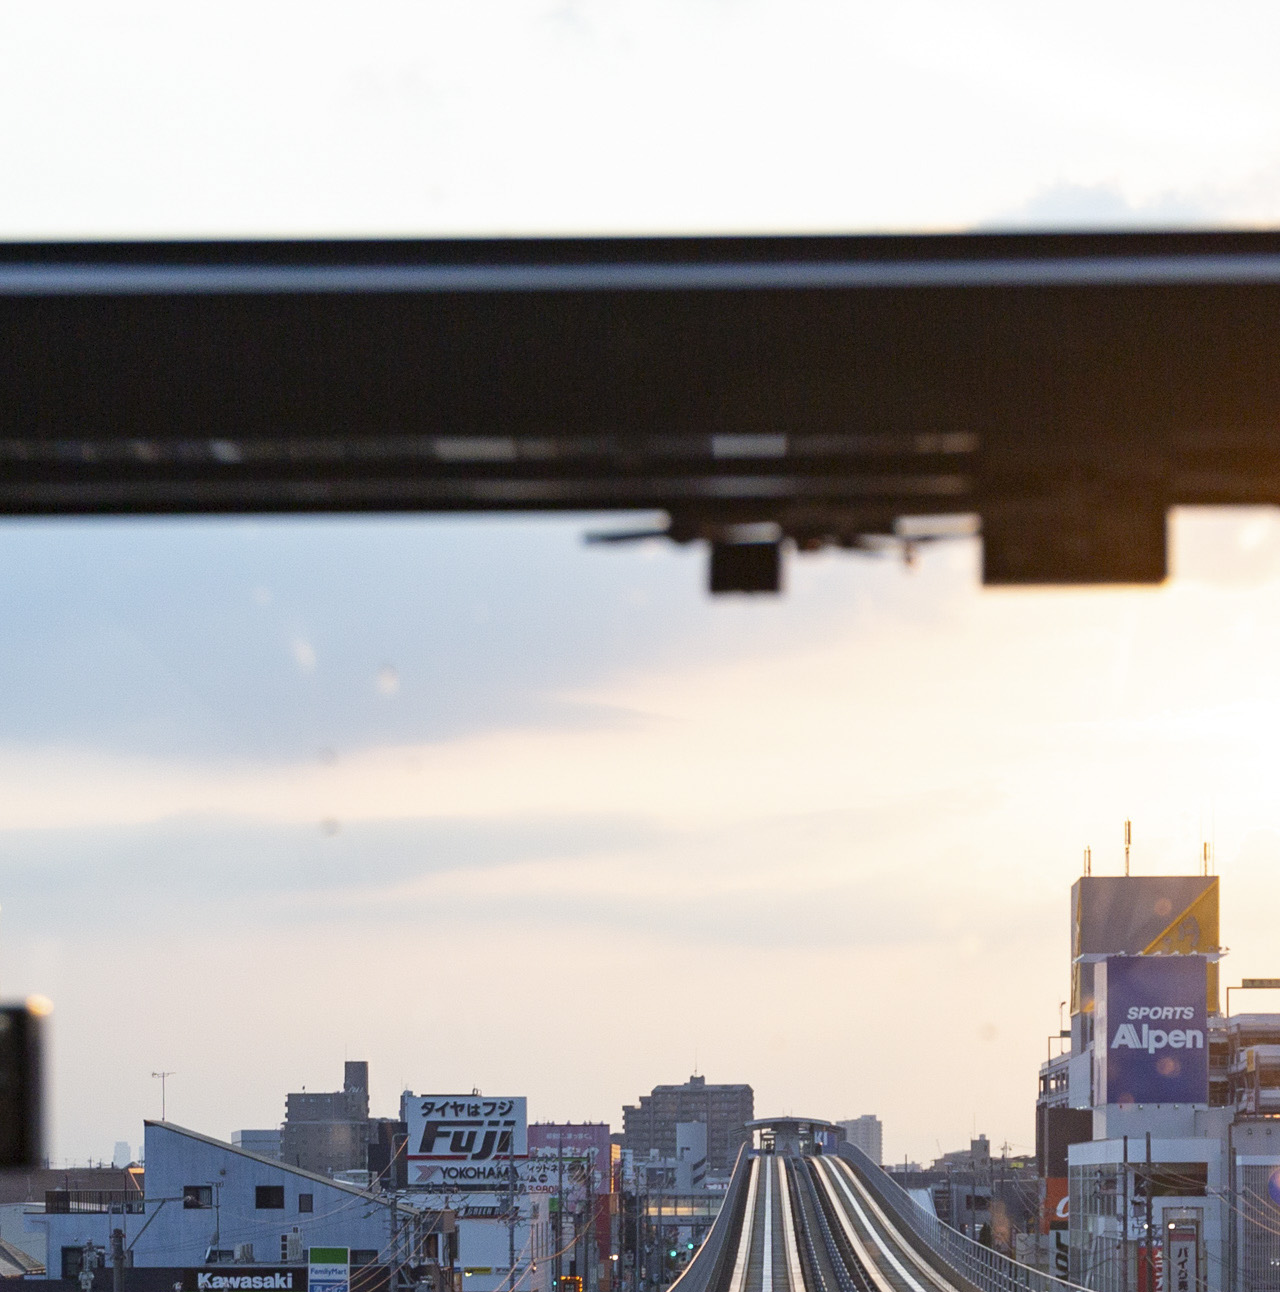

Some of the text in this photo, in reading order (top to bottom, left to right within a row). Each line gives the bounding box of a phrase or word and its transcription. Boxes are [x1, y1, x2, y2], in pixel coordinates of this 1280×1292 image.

[1127, 1006, 1195, 1020] SPORTS
[1110, 1023, 1204, 1055] Alpen
[421, 1101, 514, 1117] タイヤはフジ
[419, 1120, 516, 1160] Fuji
[440, 1166, 520, 1180] YOKOHAMA
[310, 1267, 348, 1277] FamilyMart
[197, 1272, 293, 1289] Kawasaki
